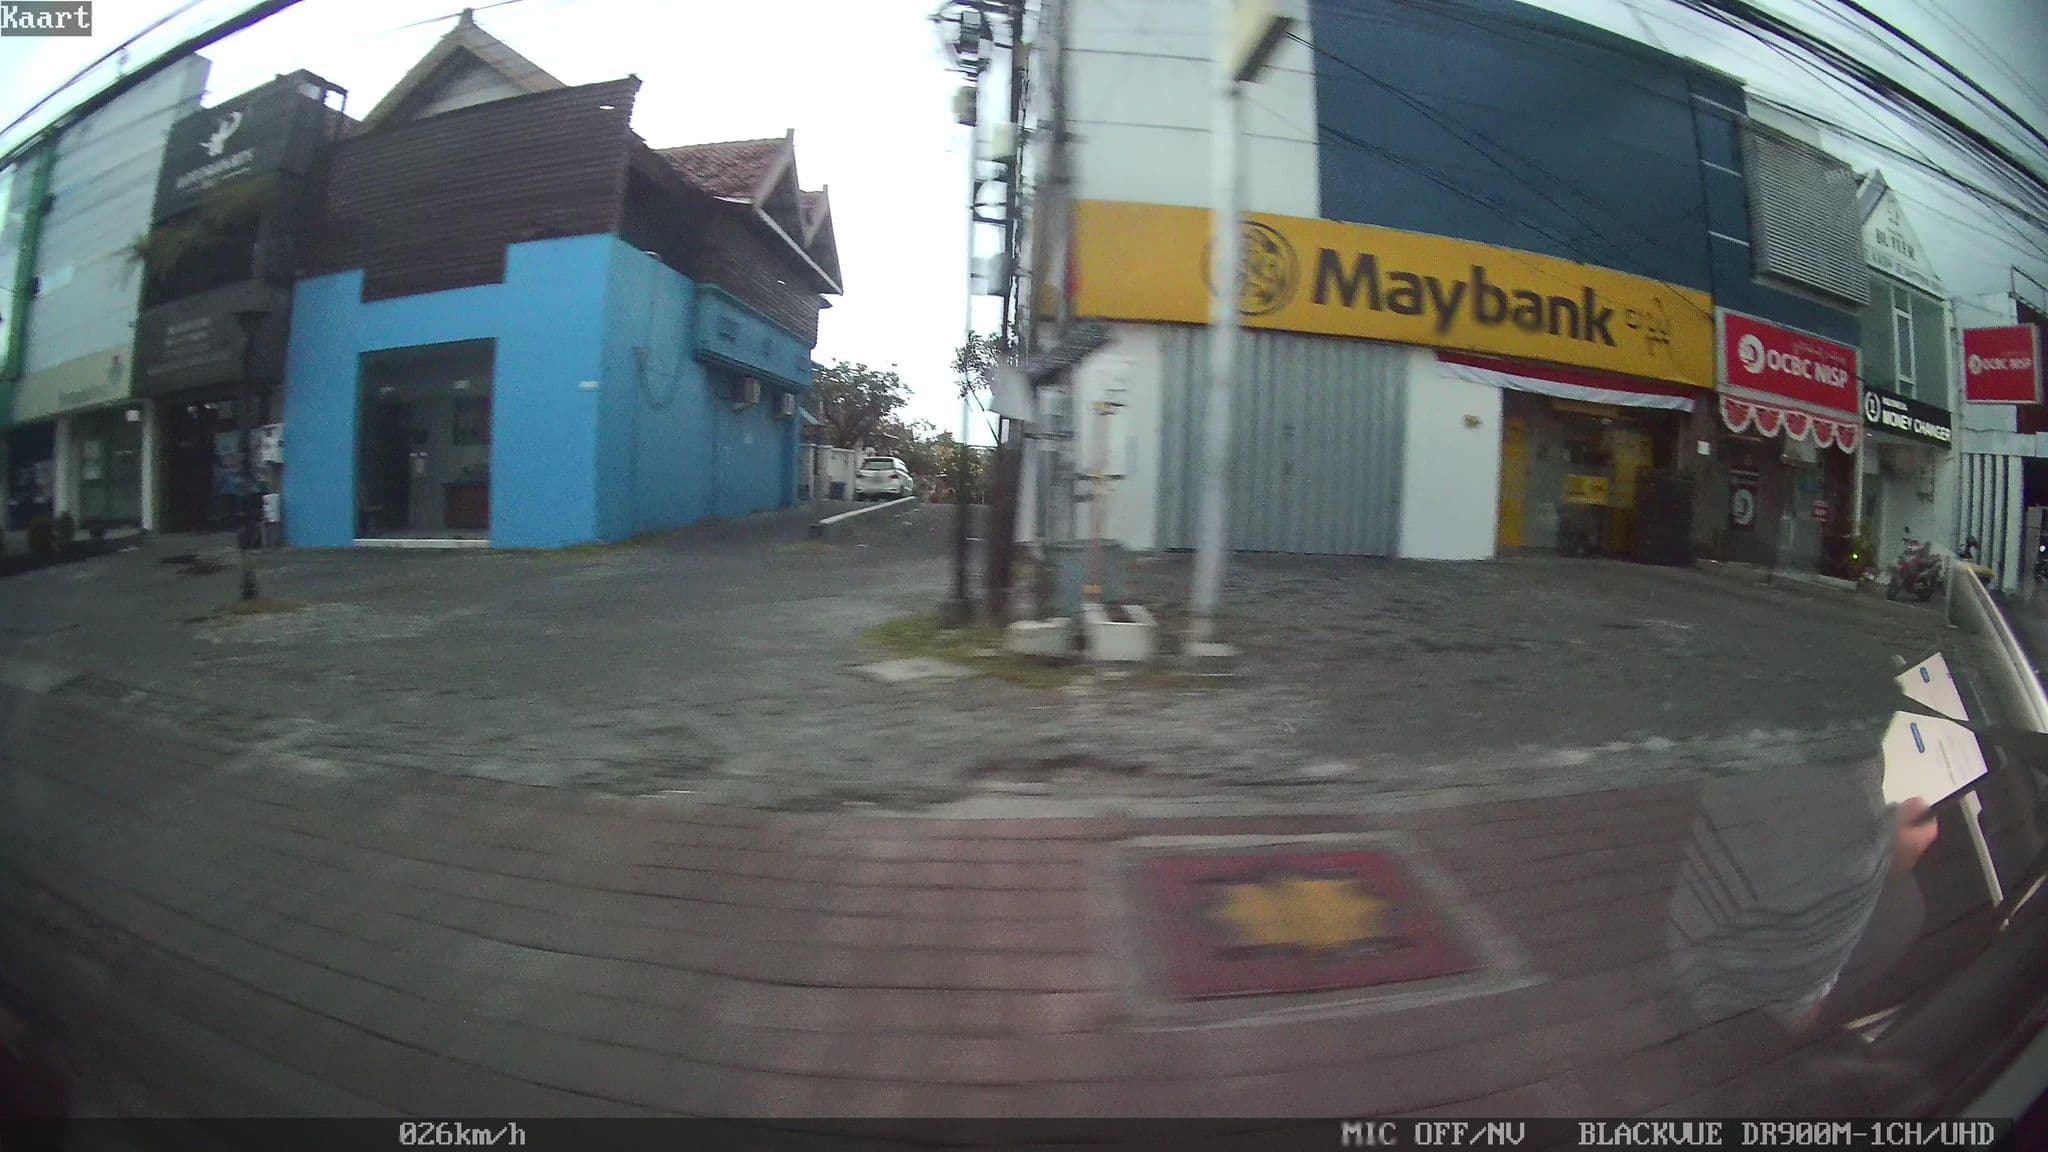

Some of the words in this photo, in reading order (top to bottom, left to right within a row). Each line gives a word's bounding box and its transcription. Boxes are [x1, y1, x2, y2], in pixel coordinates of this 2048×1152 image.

[1311, 247, 1617, 347] Maybank
[1767, 349, 1812, 380] OCBC
[1814, 361, 1849, 389] NISP
[1881, 409, 1913, 431] MONEY
